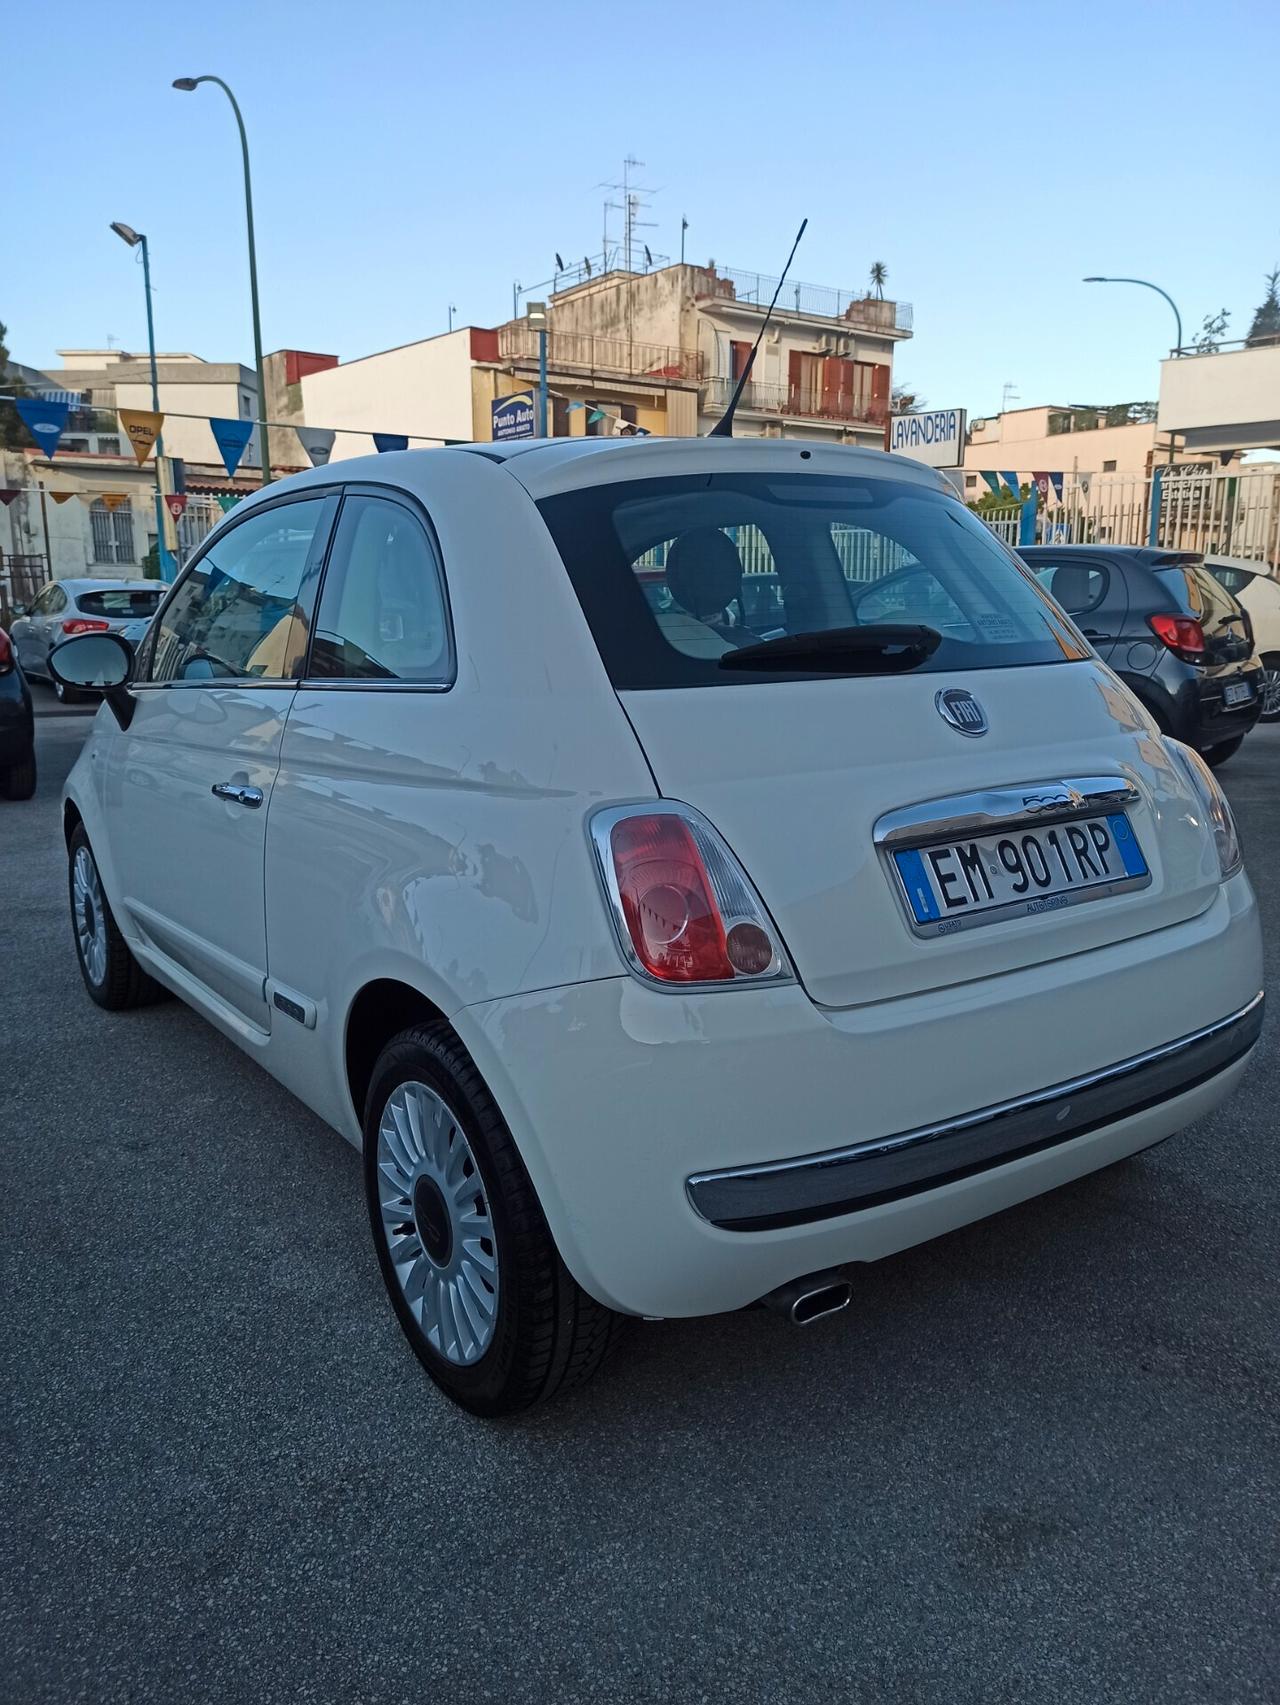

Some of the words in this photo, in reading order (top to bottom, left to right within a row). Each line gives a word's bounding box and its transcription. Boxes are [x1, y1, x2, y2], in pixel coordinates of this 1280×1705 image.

[493, 413, 515, 429] Punto
[516, 408, 534, 423] Auto
[892, 411, 956, 449] LAVANDERIA
[129, 424, 154, 437] OPEL
[950, 700, 981, 723] FIAT
[926, 844, 995, 909] EM
[997, 822, 1111, 894] 901RP
